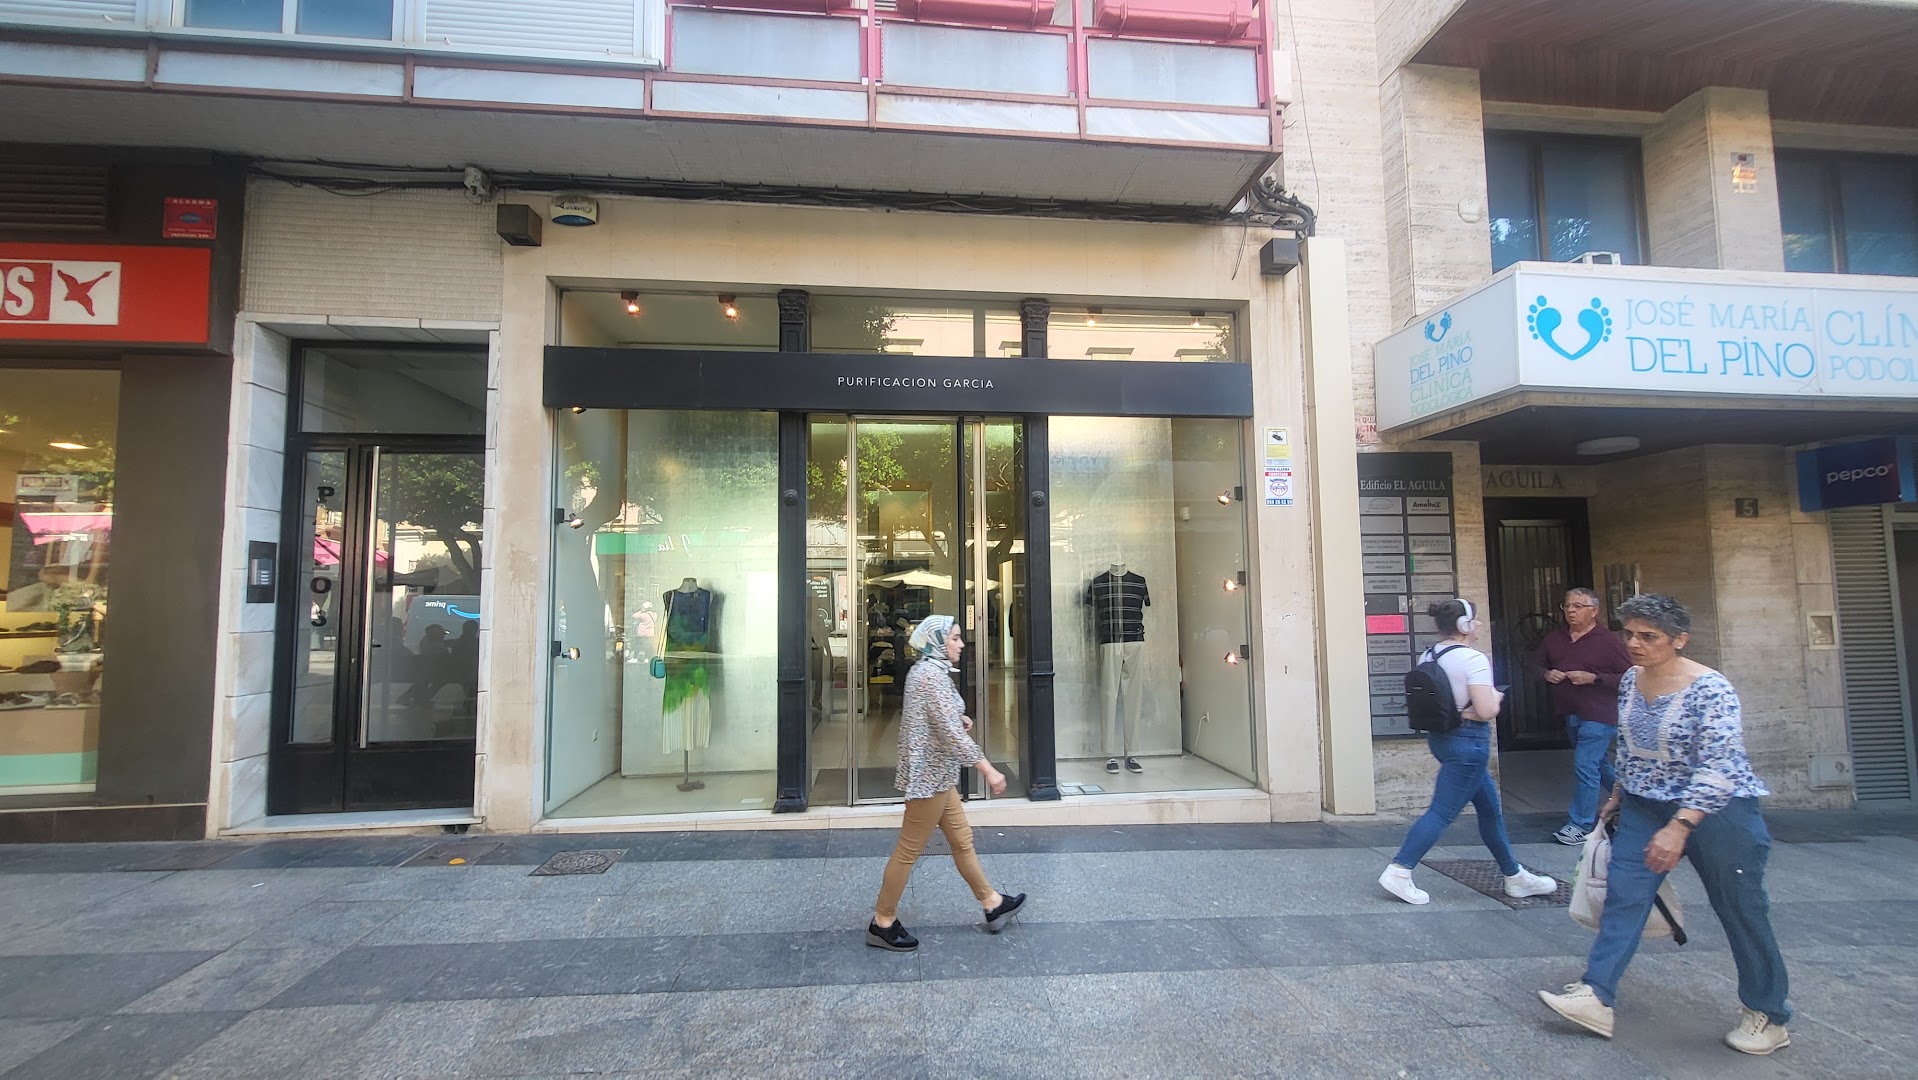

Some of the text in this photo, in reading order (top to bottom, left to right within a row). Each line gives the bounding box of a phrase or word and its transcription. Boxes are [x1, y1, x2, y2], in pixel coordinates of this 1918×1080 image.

[0, 264, 35, 317] S
[1624, 295, 1813, 332] JOSÉ MARÍA
[1409, 346, 1473, 385] DEL PINO
[1626, 335, 1816, 379] DEL PINO
[837, 376, 994, 389] PURIFICACION GARCIA
[1360, 479, 1446, 491] Edificio EL AGUILA
[1486, 469, 1564, 489] AGUILA
[1826, 464, 1889, 485] pepco
[1742, 500, 1754, 516] 5
